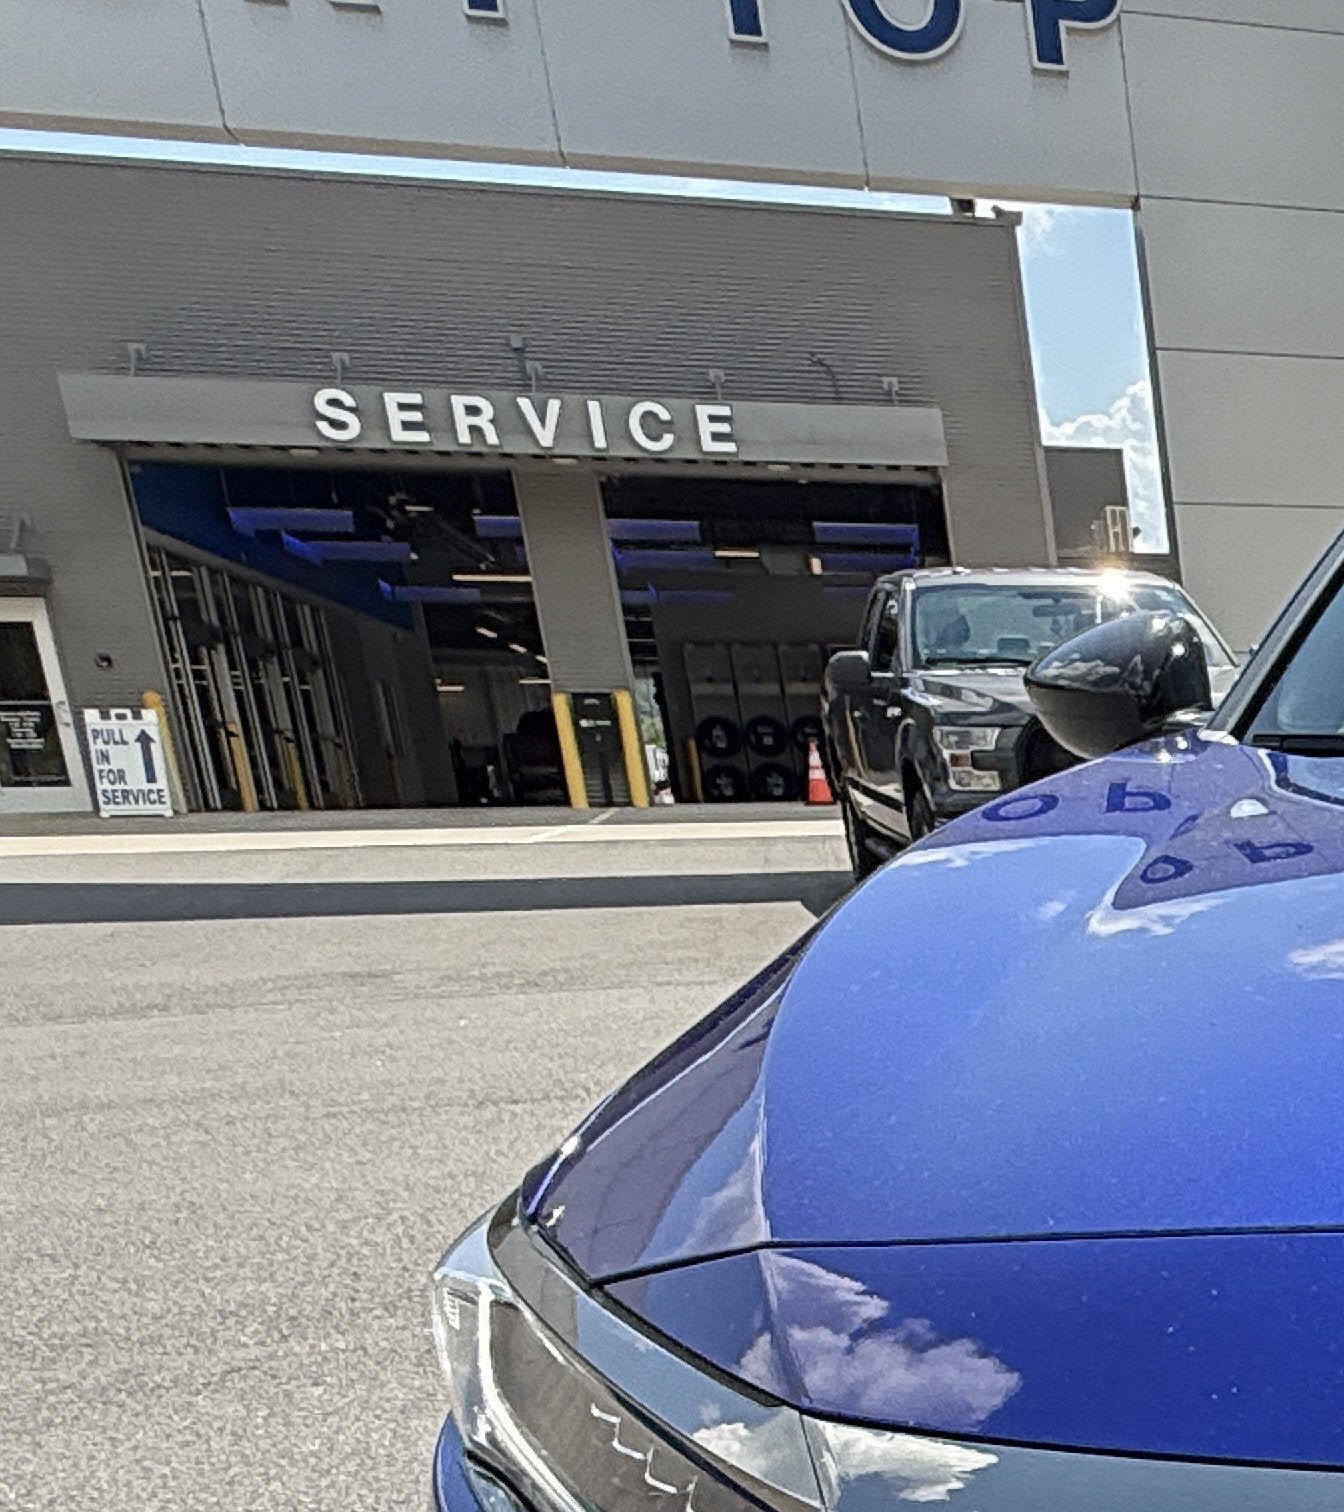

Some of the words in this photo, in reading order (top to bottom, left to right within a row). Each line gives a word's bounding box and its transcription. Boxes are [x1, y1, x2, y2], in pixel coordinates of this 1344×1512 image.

[313, 388, 738, 453] SERVICE
[91, 728, 129, 746] PULL
[95, 748, 112, 766] IN
[98, 768, 128, 786] FOR
[101, 788, 167, 805] SERVICE
